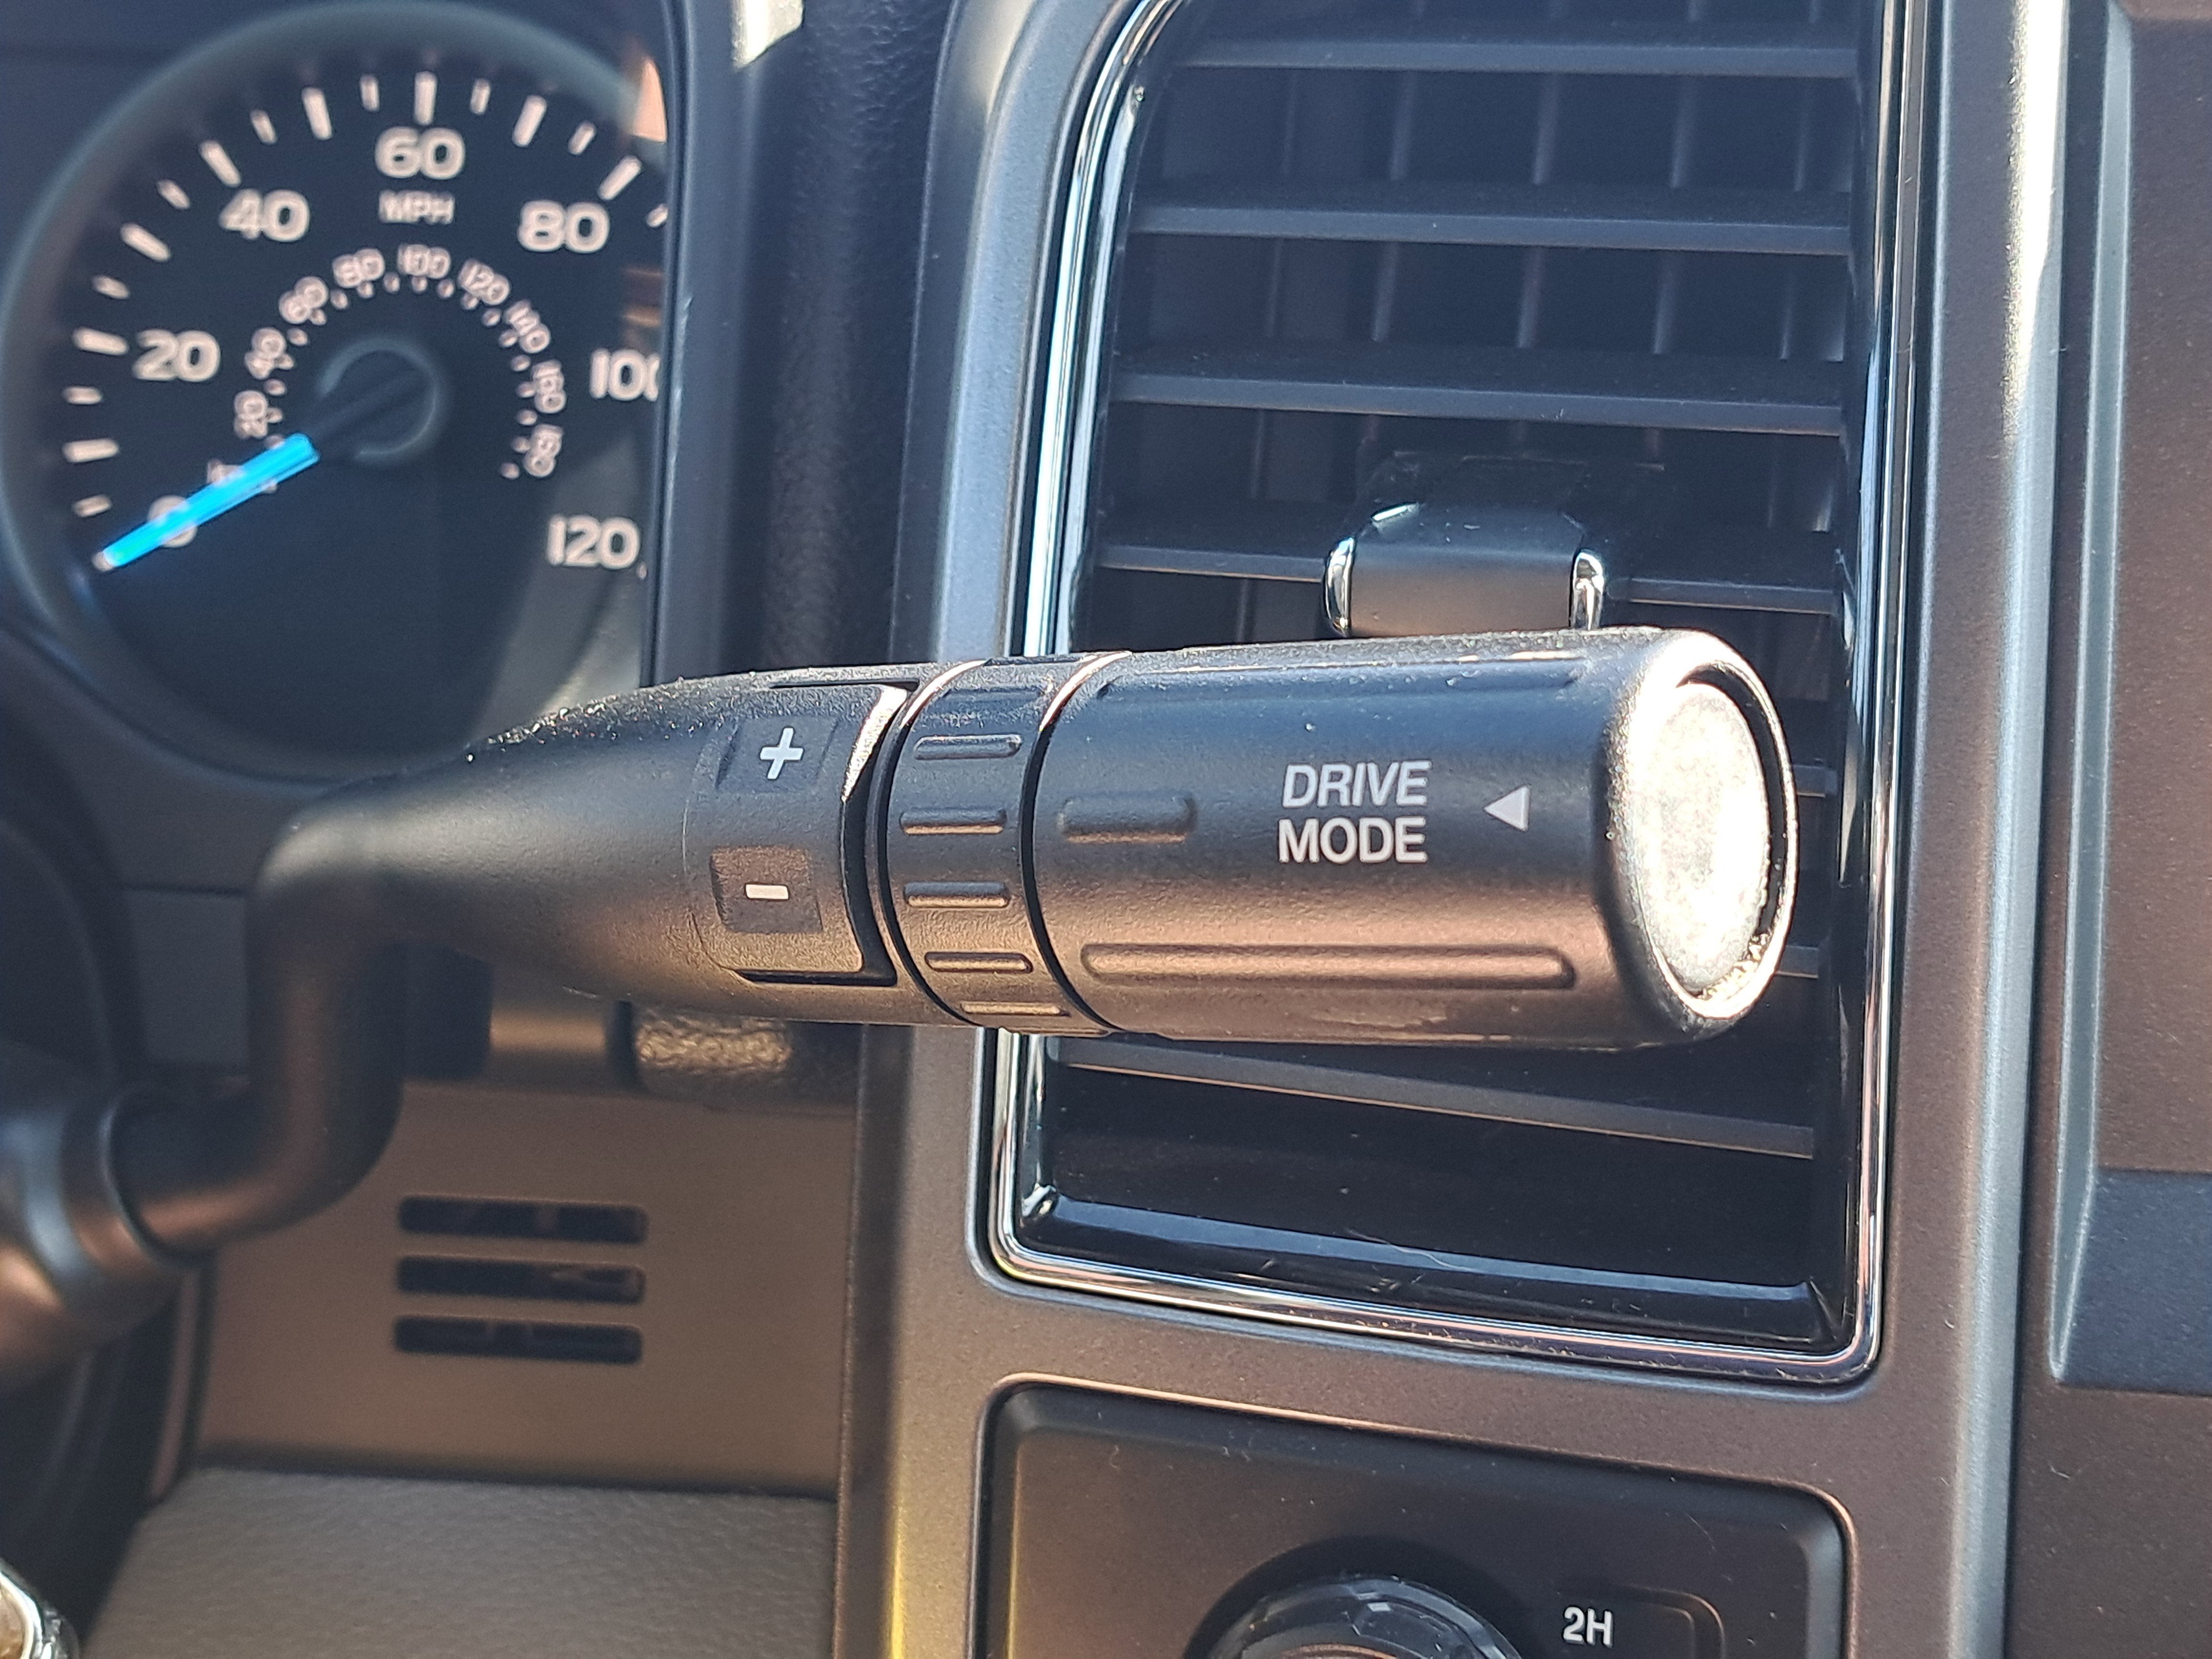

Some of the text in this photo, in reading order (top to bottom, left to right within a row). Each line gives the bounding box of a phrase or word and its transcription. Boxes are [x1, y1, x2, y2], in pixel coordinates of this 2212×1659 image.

[375, 127, 465, 179] 60
[220, 189, 310, 242] 40
[379, 190, 455, 224] MPH
[517, 199, 610, 253] 80
[397, 243, 451, 279] 100
[457, 258, 510, 305] 120
[133, 329, 221, 382] 20
[545, 514, 640, 569] 120
[1282, 760, 1432, 808] DRIVE
[1278, 815, 1428, 863] MODE
[1562, 1606, 1613, 1647] 2H
